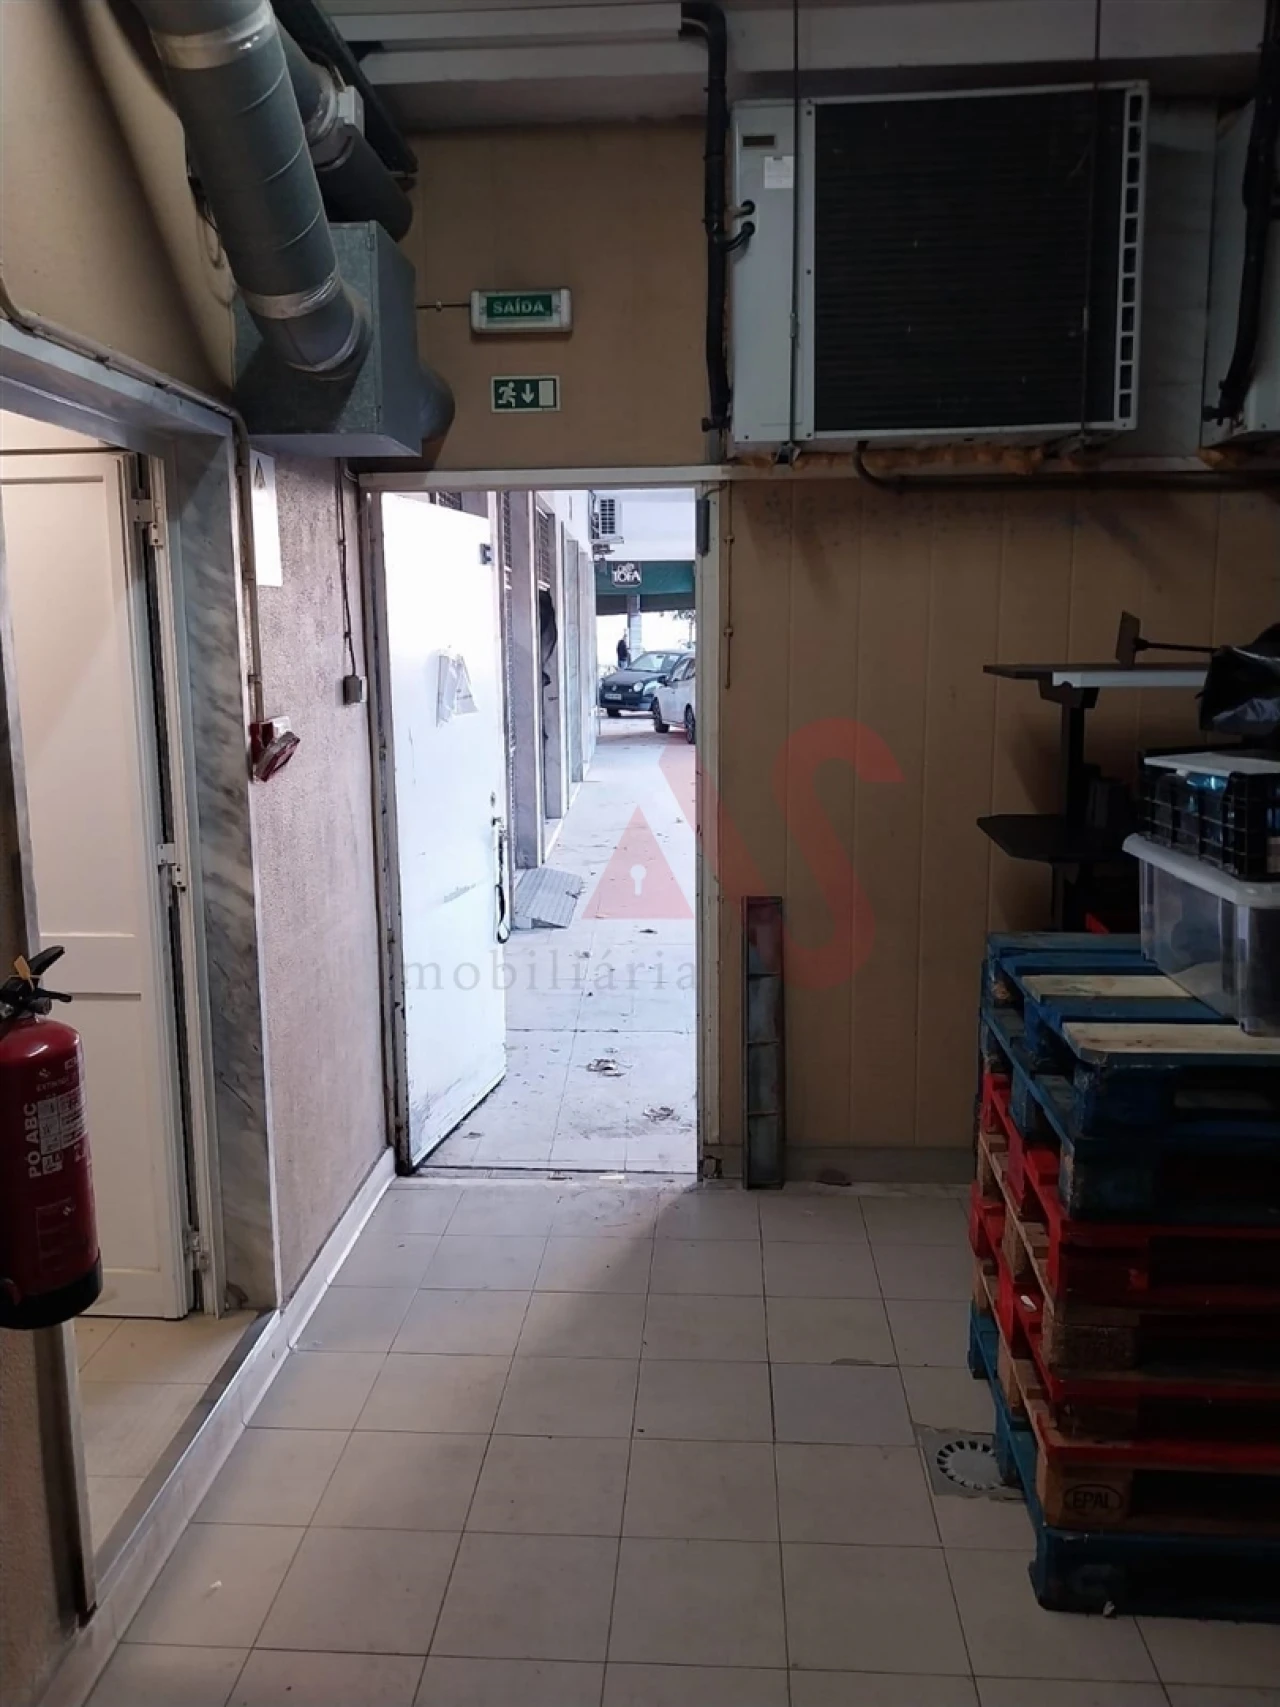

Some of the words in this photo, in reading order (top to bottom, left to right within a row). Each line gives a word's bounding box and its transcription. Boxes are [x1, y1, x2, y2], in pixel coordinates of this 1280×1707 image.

[492, 298, 545, 314] SAÍDA
[23, 1102, 40, 1144] ABC
[24, 1150, 42, 1178] PÓ
